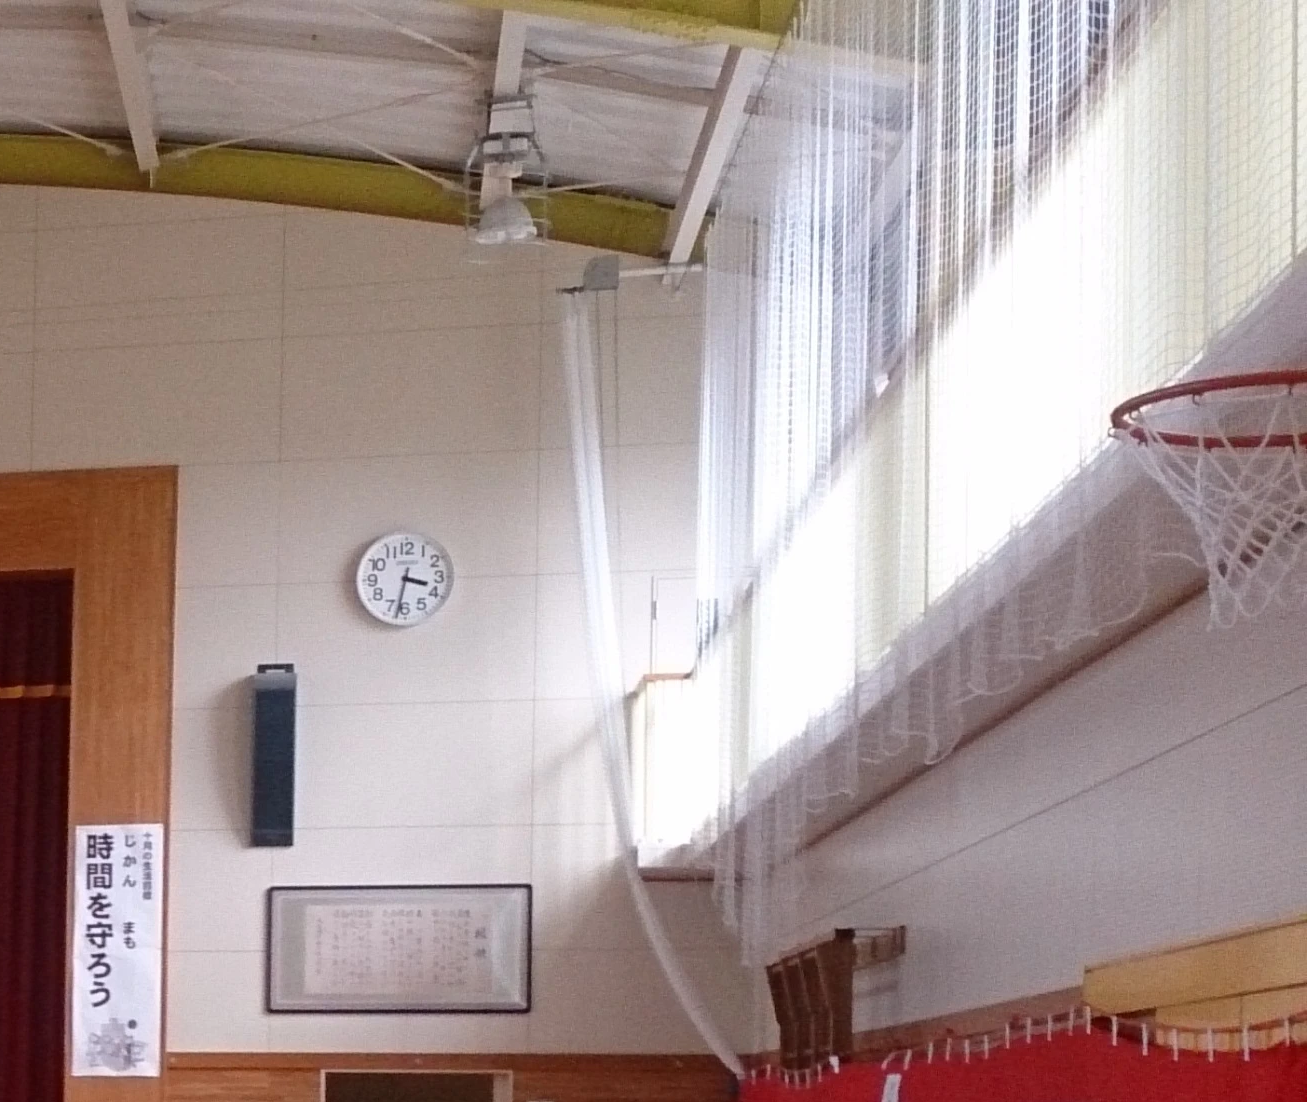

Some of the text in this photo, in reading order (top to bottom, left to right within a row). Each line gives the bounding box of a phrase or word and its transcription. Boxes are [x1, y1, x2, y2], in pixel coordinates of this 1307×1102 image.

[385, 543, 397, 559] 11
[399, 542, 415, 556] 12
[421, 544, 425, 557] 1
[369, 558, 386, 572] 10
[430, 555, 440, 568] 2
[367, 574, 378, 587] 9
[434, 571, 444, 584] 3
[373, 587, 383, 601] 8
[428, 586, 439, 599] 4
[385, 599, 395, 612] 7
[400, 602, 411, 615] 6
[416, 598, 427, 611] 5
[121, 834, 137, 950] じかん まも
[85, 834, 114, 1008] 時間を守ろう
